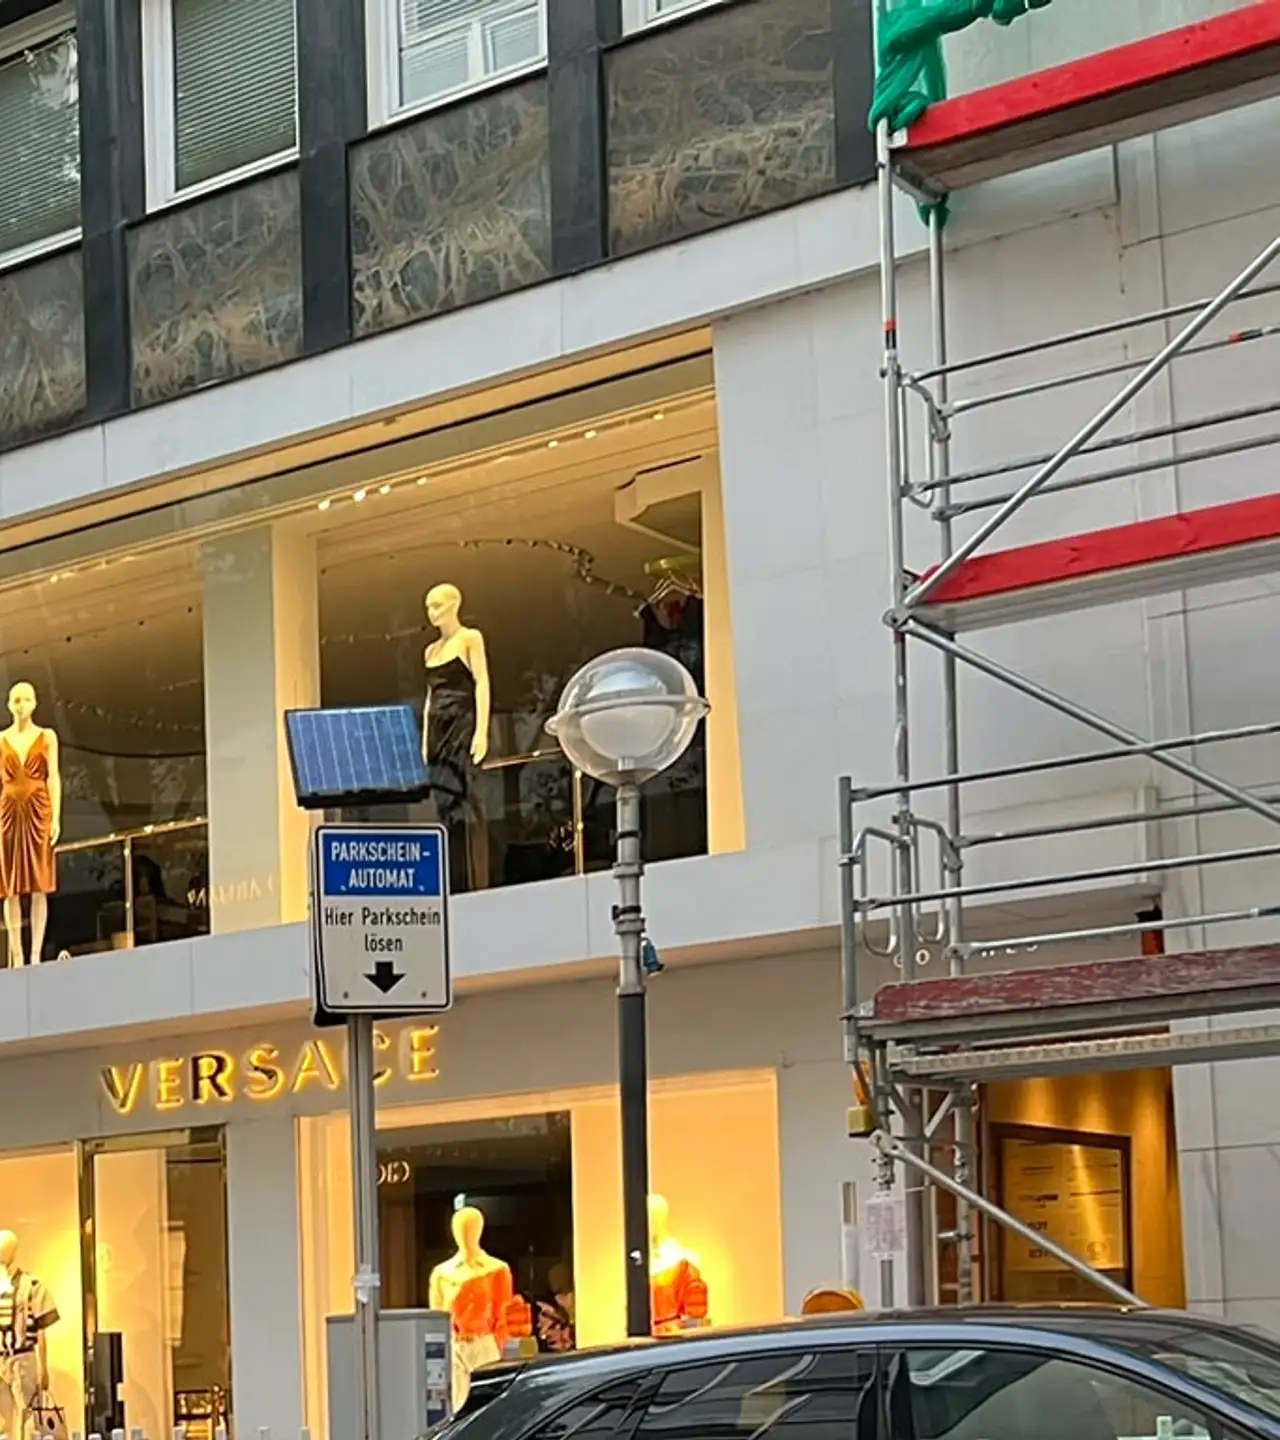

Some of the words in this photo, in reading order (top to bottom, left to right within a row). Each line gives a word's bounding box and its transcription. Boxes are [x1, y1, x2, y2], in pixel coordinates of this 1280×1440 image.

[331, 841, 431, 862] PARKSCHEIN-
[348, 867, 415, 889] AUTOMAT
[325, 906, 354, 926] Hier
[361, 905, 441, 926] Parkschein
[364, 932, 403, 952] lösen
